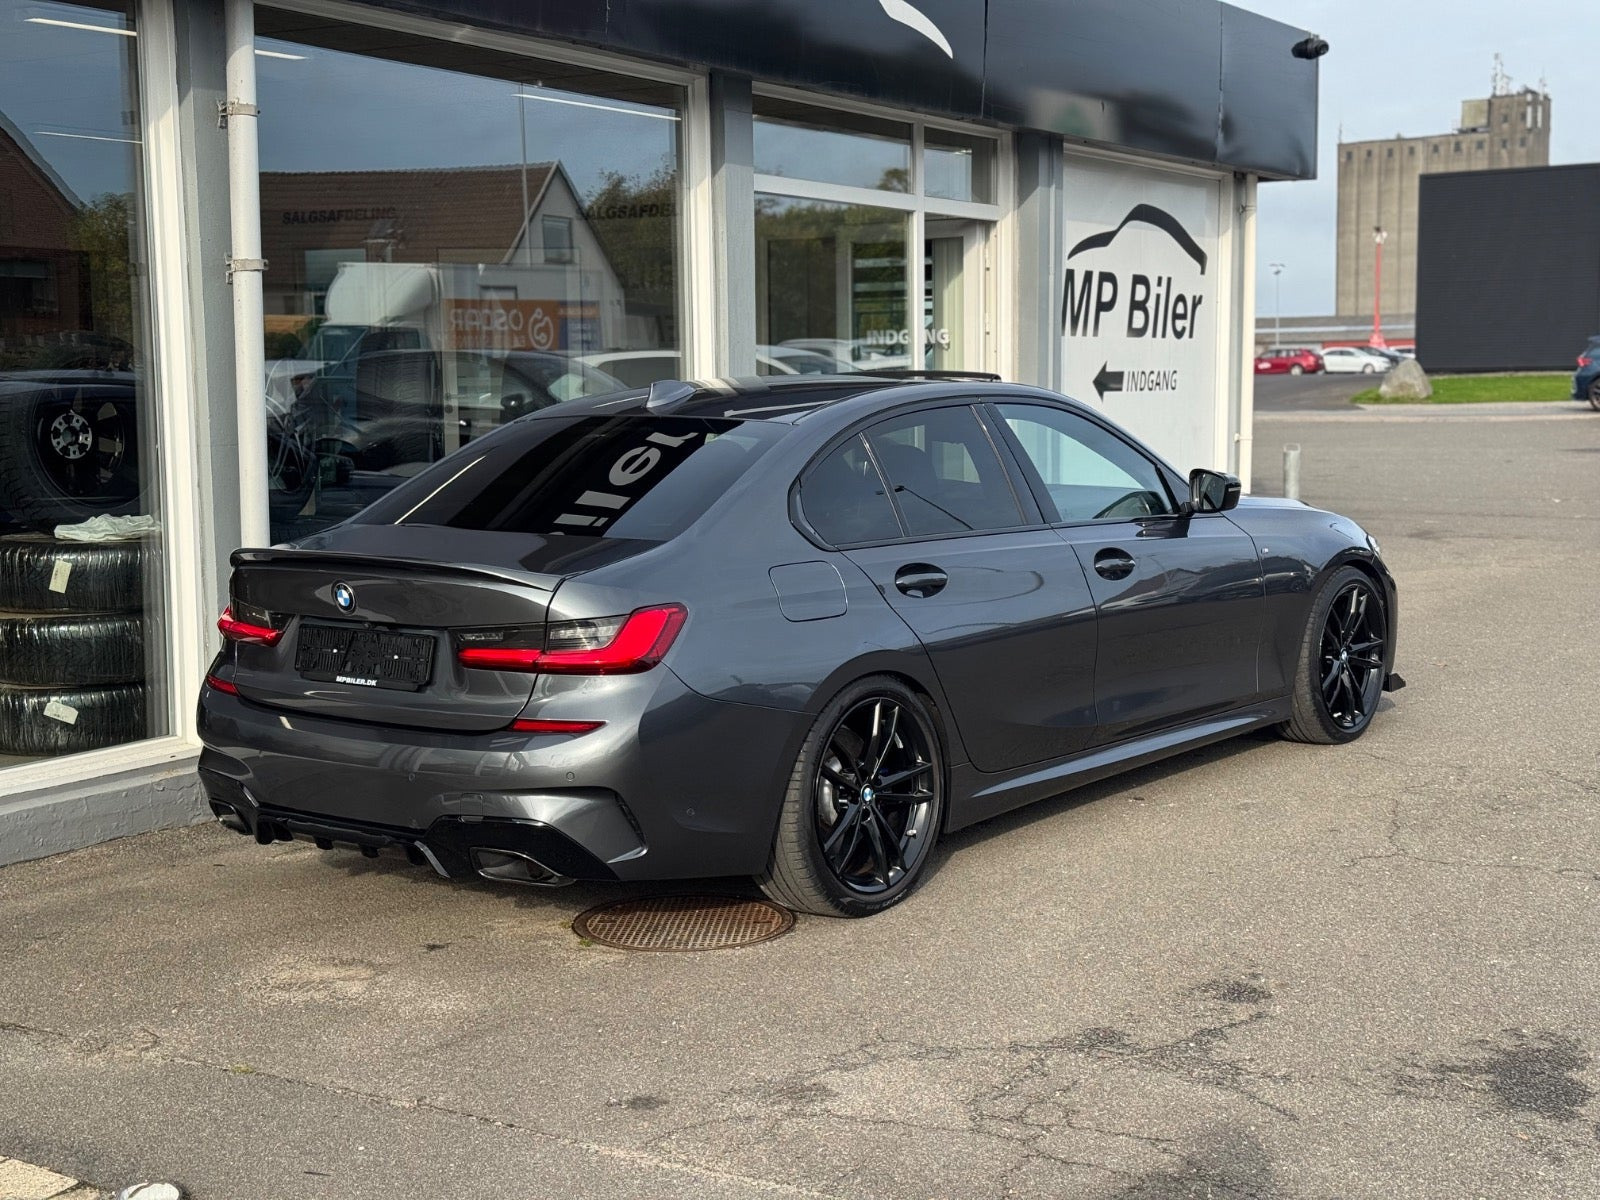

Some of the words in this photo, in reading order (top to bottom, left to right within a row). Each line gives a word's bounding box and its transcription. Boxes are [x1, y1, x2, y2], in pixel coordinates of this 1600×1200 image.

[1061, 268, 1118, 337] MP
[1126, 273, 1203, 340] Biler
[866, 328, 951, 345] INDGNG
[1126, 370, 1178, 392] INDGANG
[335, 675, 378, 686] MPBILER.DK
